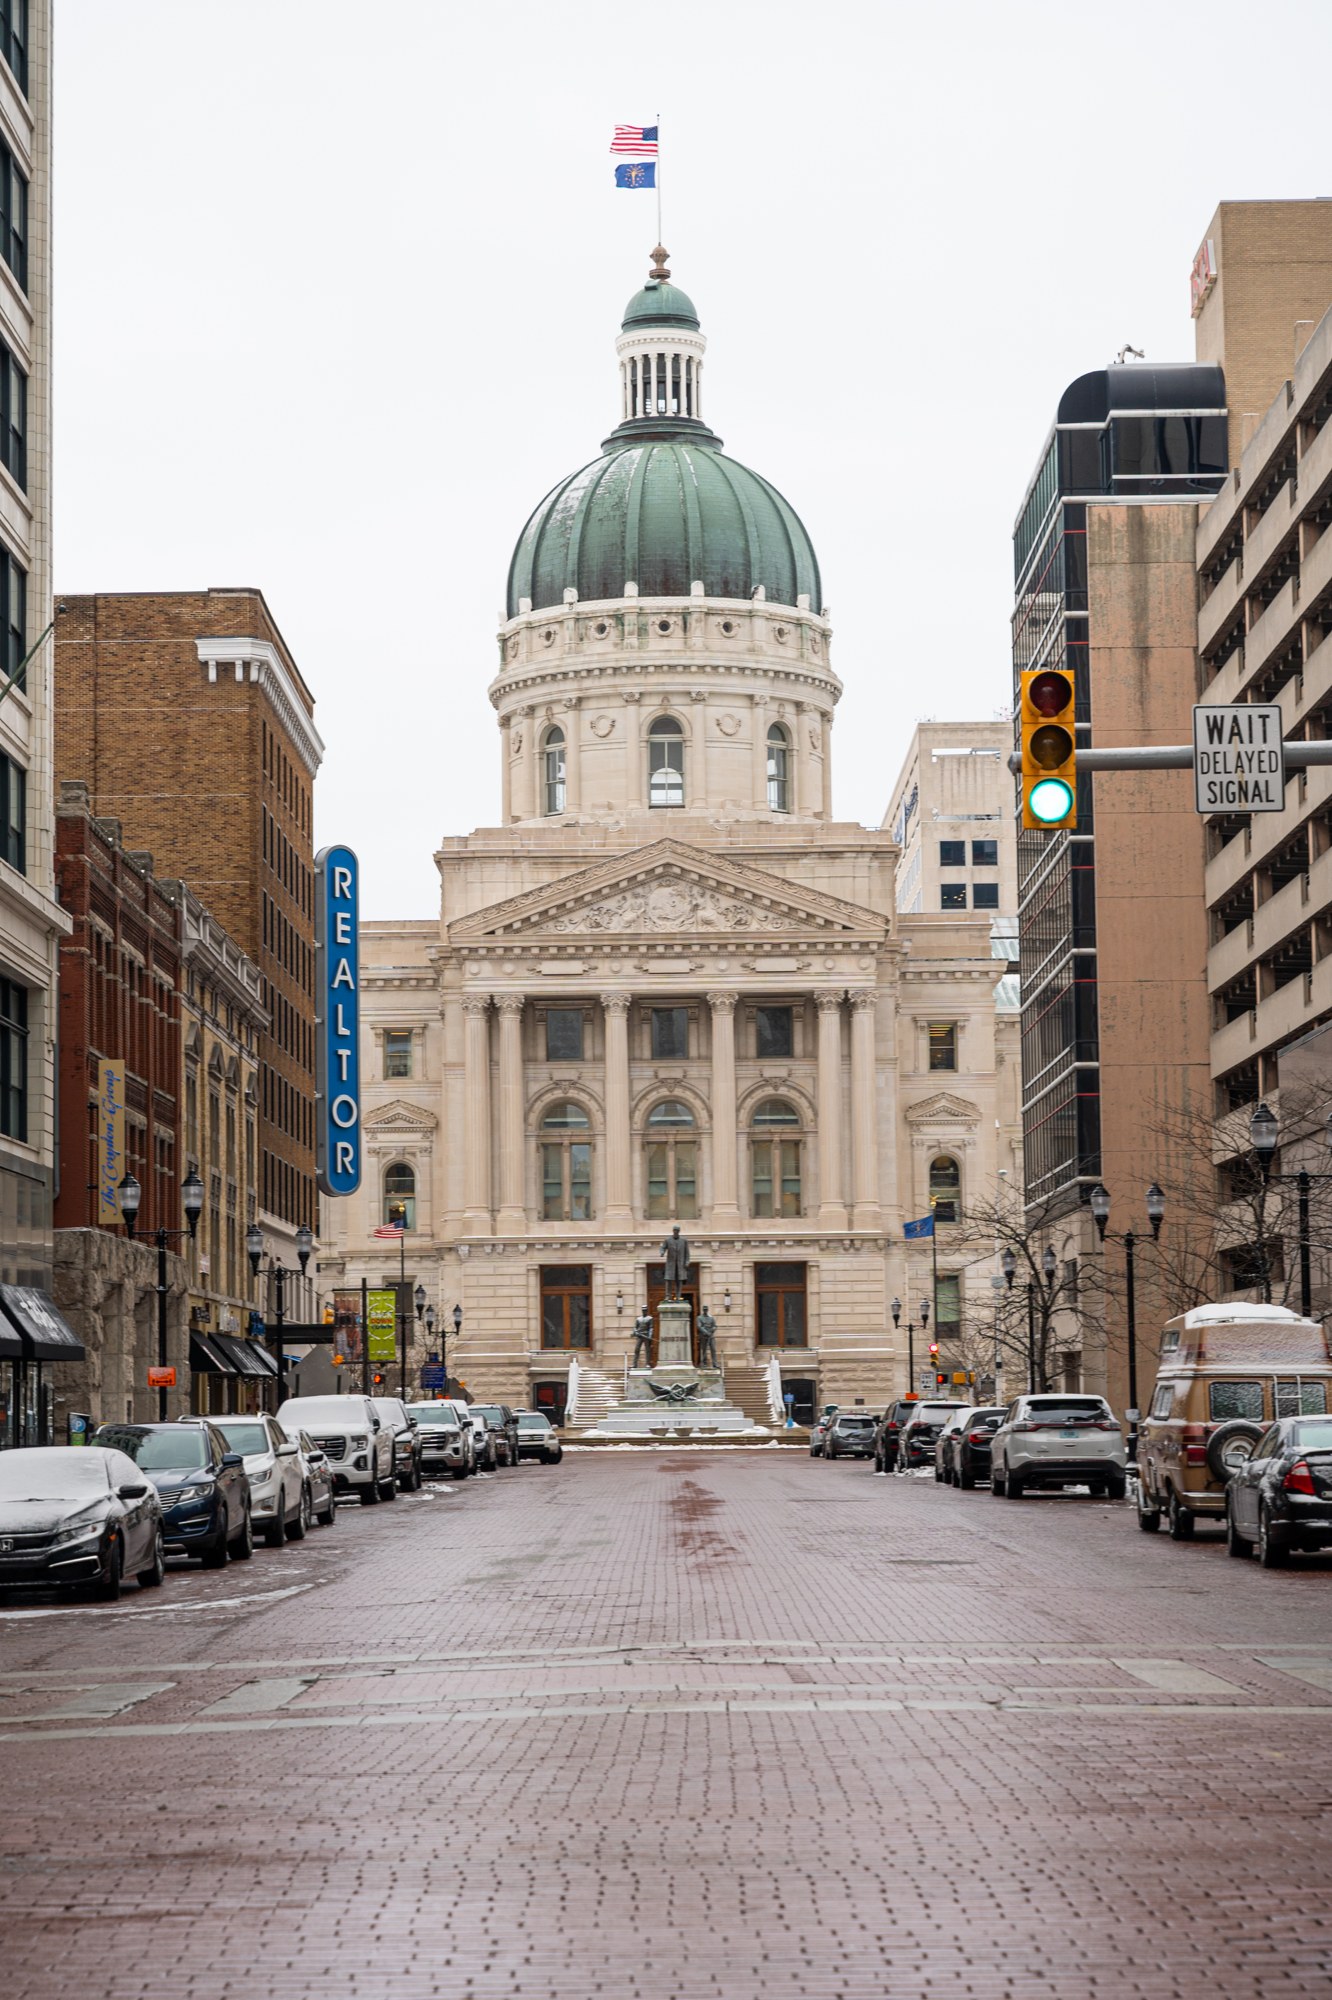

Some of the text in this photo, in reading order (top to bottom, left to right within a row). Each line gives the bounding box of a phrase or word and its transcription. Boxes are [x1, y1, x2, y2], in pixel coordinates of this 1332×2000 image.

[1206, 714, 1270, 745] WAIT
[1200, 750, 1279, 775] DELAYED
[1207, 780, 1275, 804] SIGNAL
[330, 866, 358, 1175] REALTOR
[102, 1069, 123, 1120] Group
[101, 1185, 118, 1216] The
